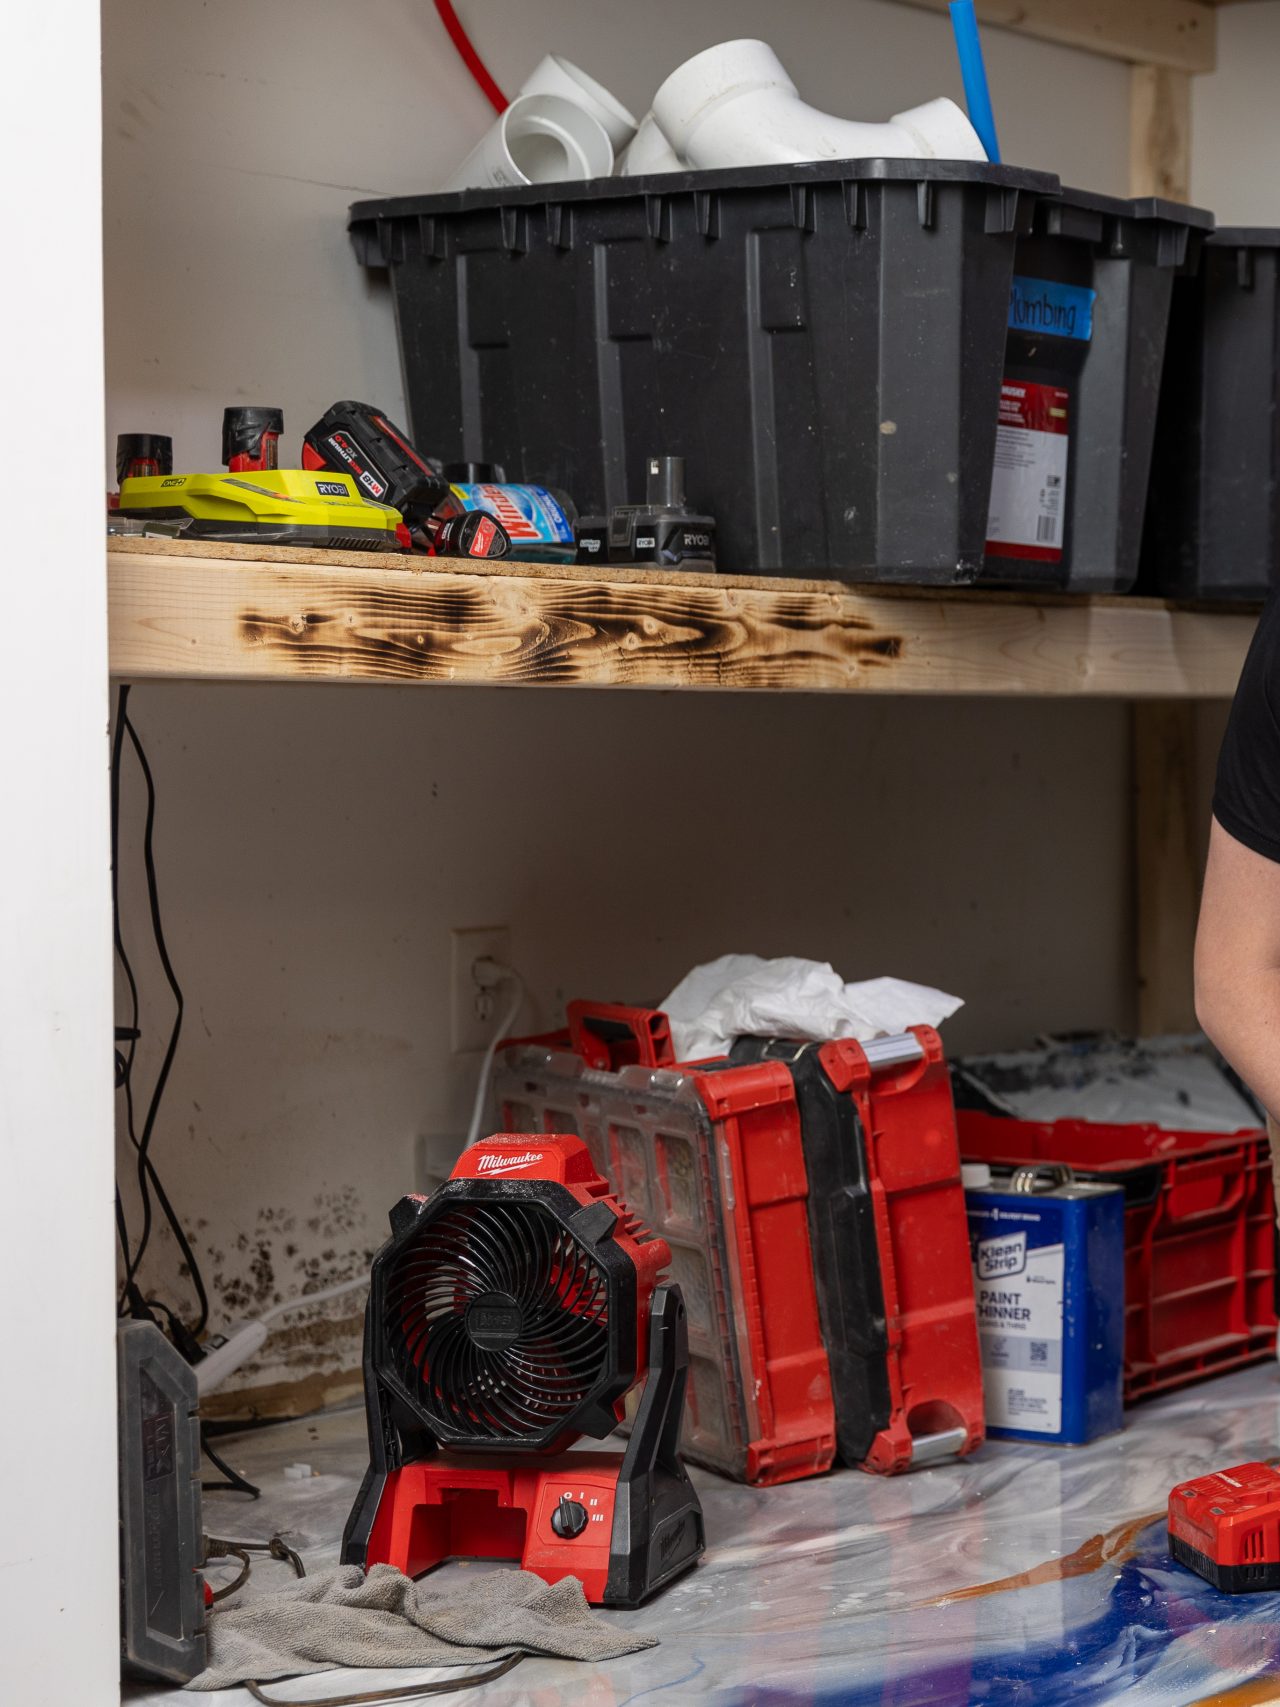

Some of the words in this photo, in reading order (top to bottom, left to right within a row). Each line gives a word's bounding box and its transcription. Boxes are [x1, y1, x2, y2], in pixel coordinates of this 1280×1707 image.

[317, 483, 348, 495] RYOBI
[362, 475, 382, 494] M18
[683, 533, 710, 546] RYOB
[477, 1151, 543, 1171] Milwaukee
[980, 1243, 1022, 1260] Klean
[985, 1257, 1017, 1272] Strip
[980, 1291, 1021, 1305] PAINT
